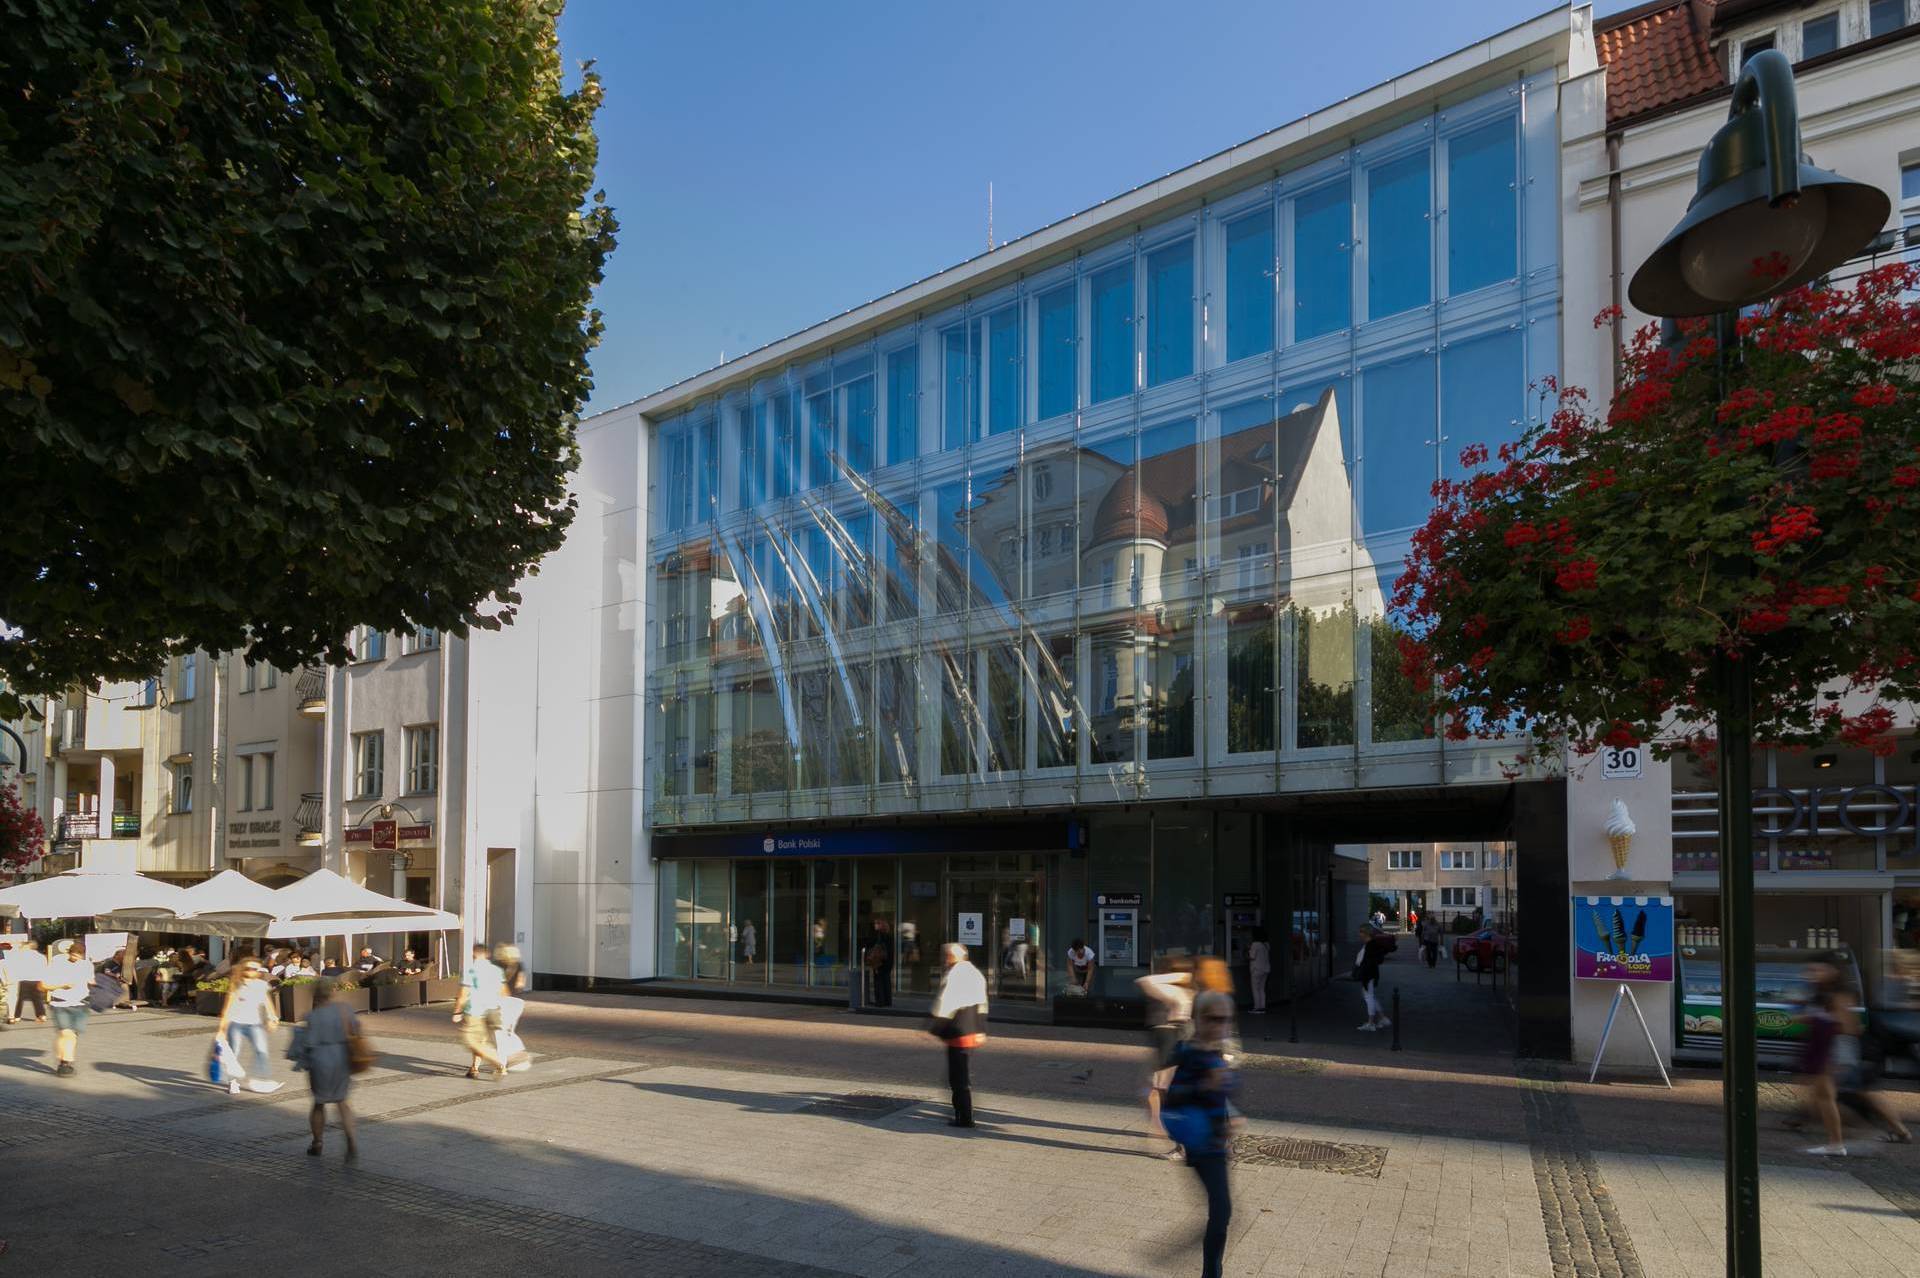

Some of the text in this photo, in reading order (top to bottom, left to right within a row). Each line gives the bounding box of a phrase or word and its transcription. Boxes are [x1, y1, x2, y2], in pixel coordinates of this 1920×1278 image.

[1607, 750, 1637, 769] 30
[778, 838, 821, 849] Bank Polski
